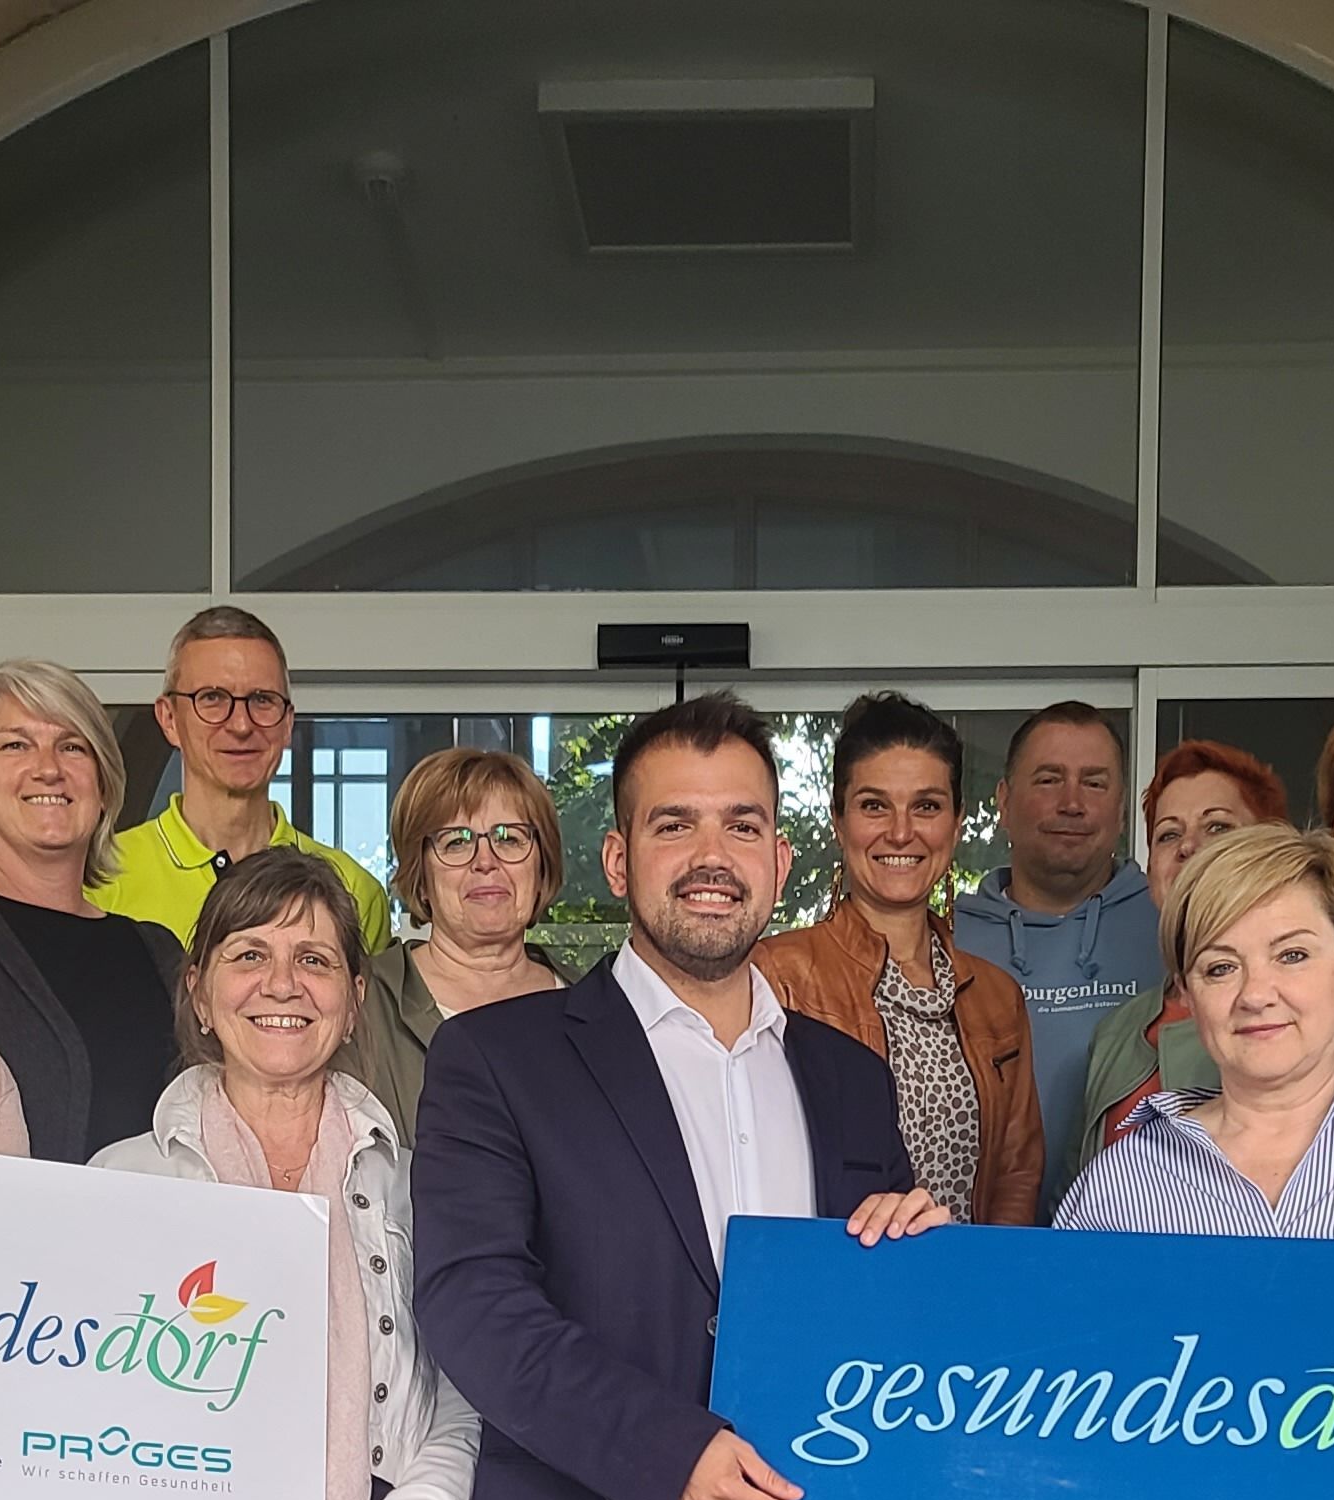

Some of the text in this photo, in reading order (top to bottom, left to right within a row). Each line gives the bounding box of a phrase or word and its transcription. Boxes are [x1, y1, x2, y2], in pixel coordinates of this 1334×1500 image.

[1021, 979, 1138, 1005] burgenland
[20, 1463, 233, 1493] Wir schaffen Gesundheit
